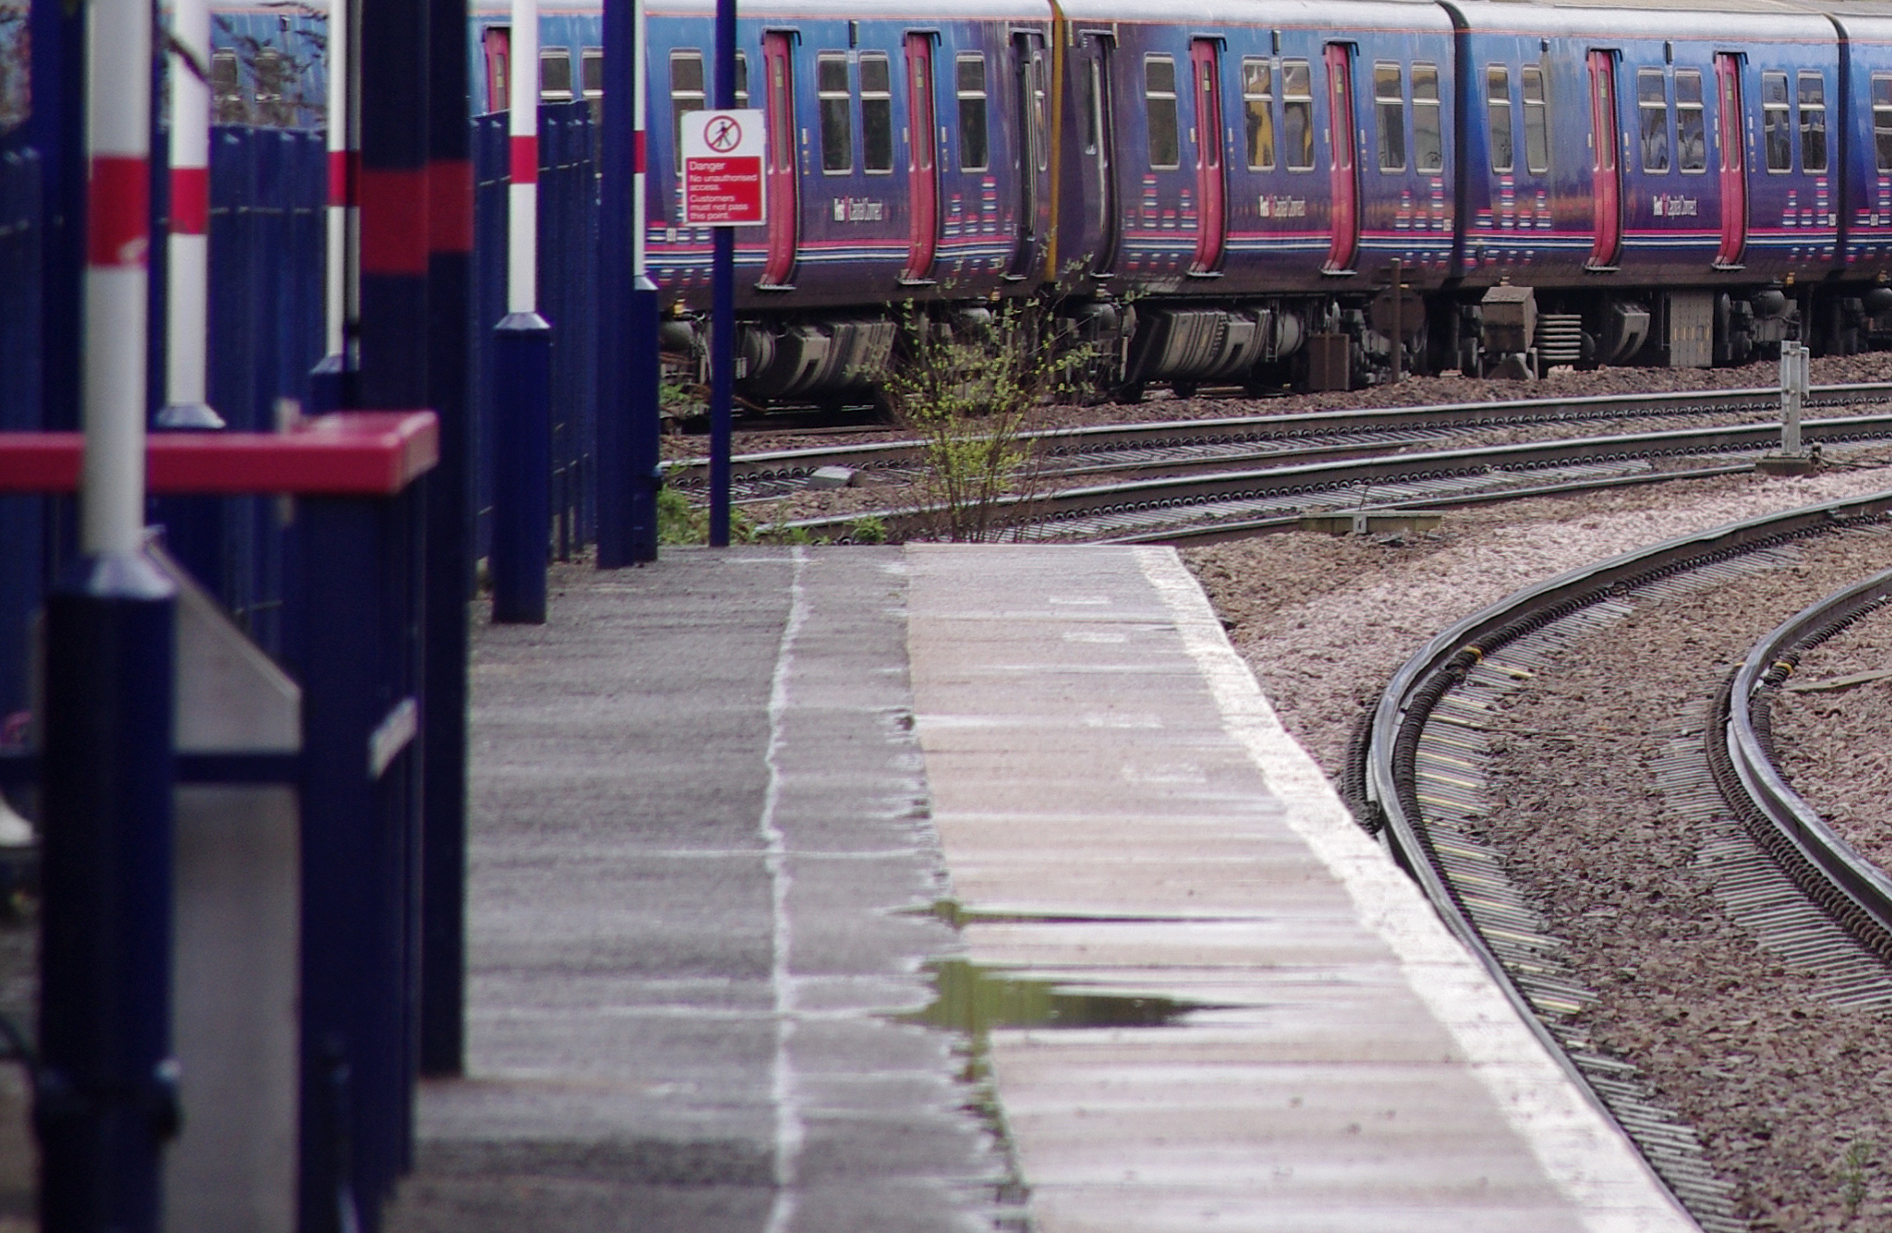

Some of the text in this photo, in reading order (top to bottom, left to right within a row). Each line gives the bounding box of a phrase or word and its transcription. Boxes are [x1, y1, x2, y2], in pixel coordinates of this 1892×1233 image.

[689, 161, 726, 173] Danger
[689, 174, 758, 183] No unauthorised
[689, 194, 736, 203] Customers
[728, 204, 749, 212] pass
